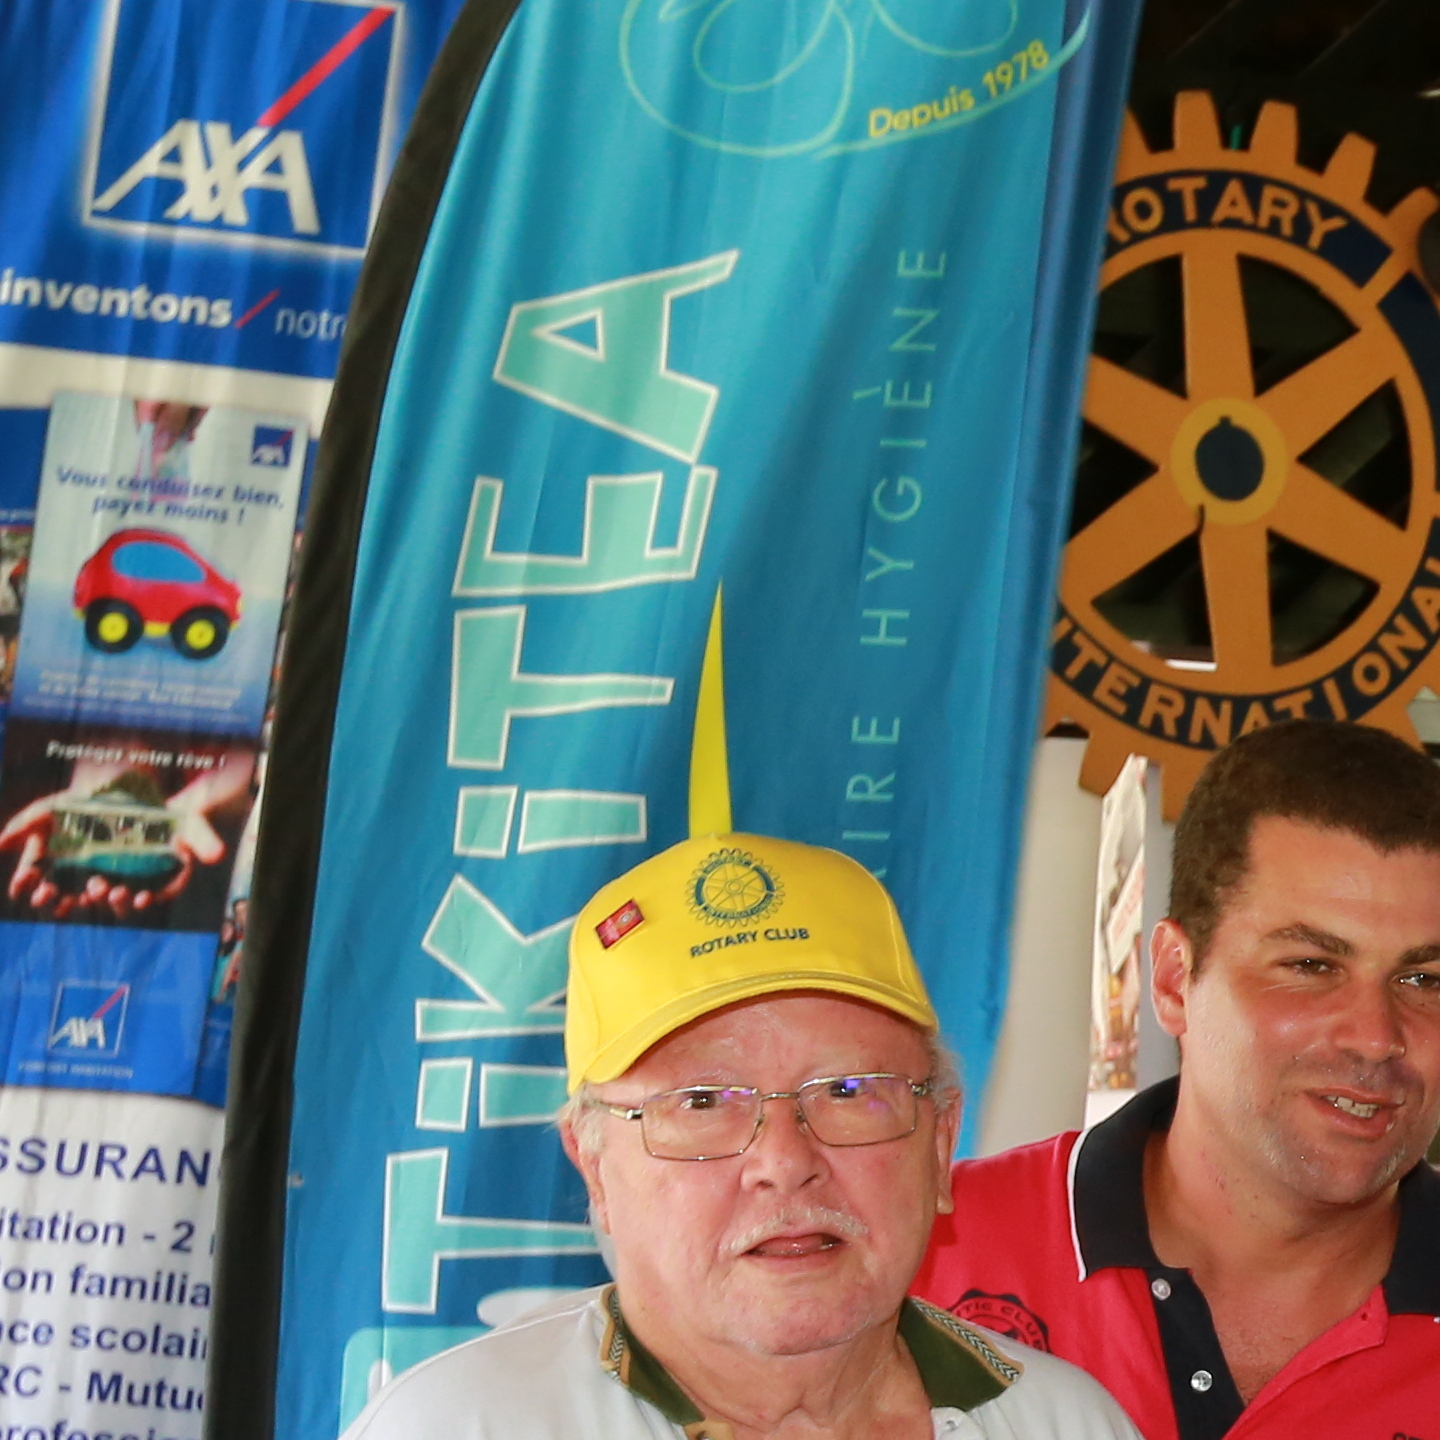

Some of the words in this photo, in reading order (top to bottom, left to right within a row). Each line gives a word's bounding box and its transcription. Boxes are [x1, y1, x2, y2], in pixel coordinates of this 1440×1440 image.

[868, 86, 977, 139] Depuis
[981, 40, 1050, 98] 1978
[93, 119, 320, 234] AXA
[1, 267, 233, 328] inventons
[854, 248, 947, 647] HYGIÈNE
[56, 465, 107, 488] Vous
[164, 501, 228, 525] moins
[129, 749, 172, 768] votre
[842, 714, 900, 880] IRE
[690, 929, 757, 958] ROTARY
[763, 926, 810, 942] CLUB
[171, 1221, 195, 1252] 2
[87, 1370, 202, 1412] Mutu
